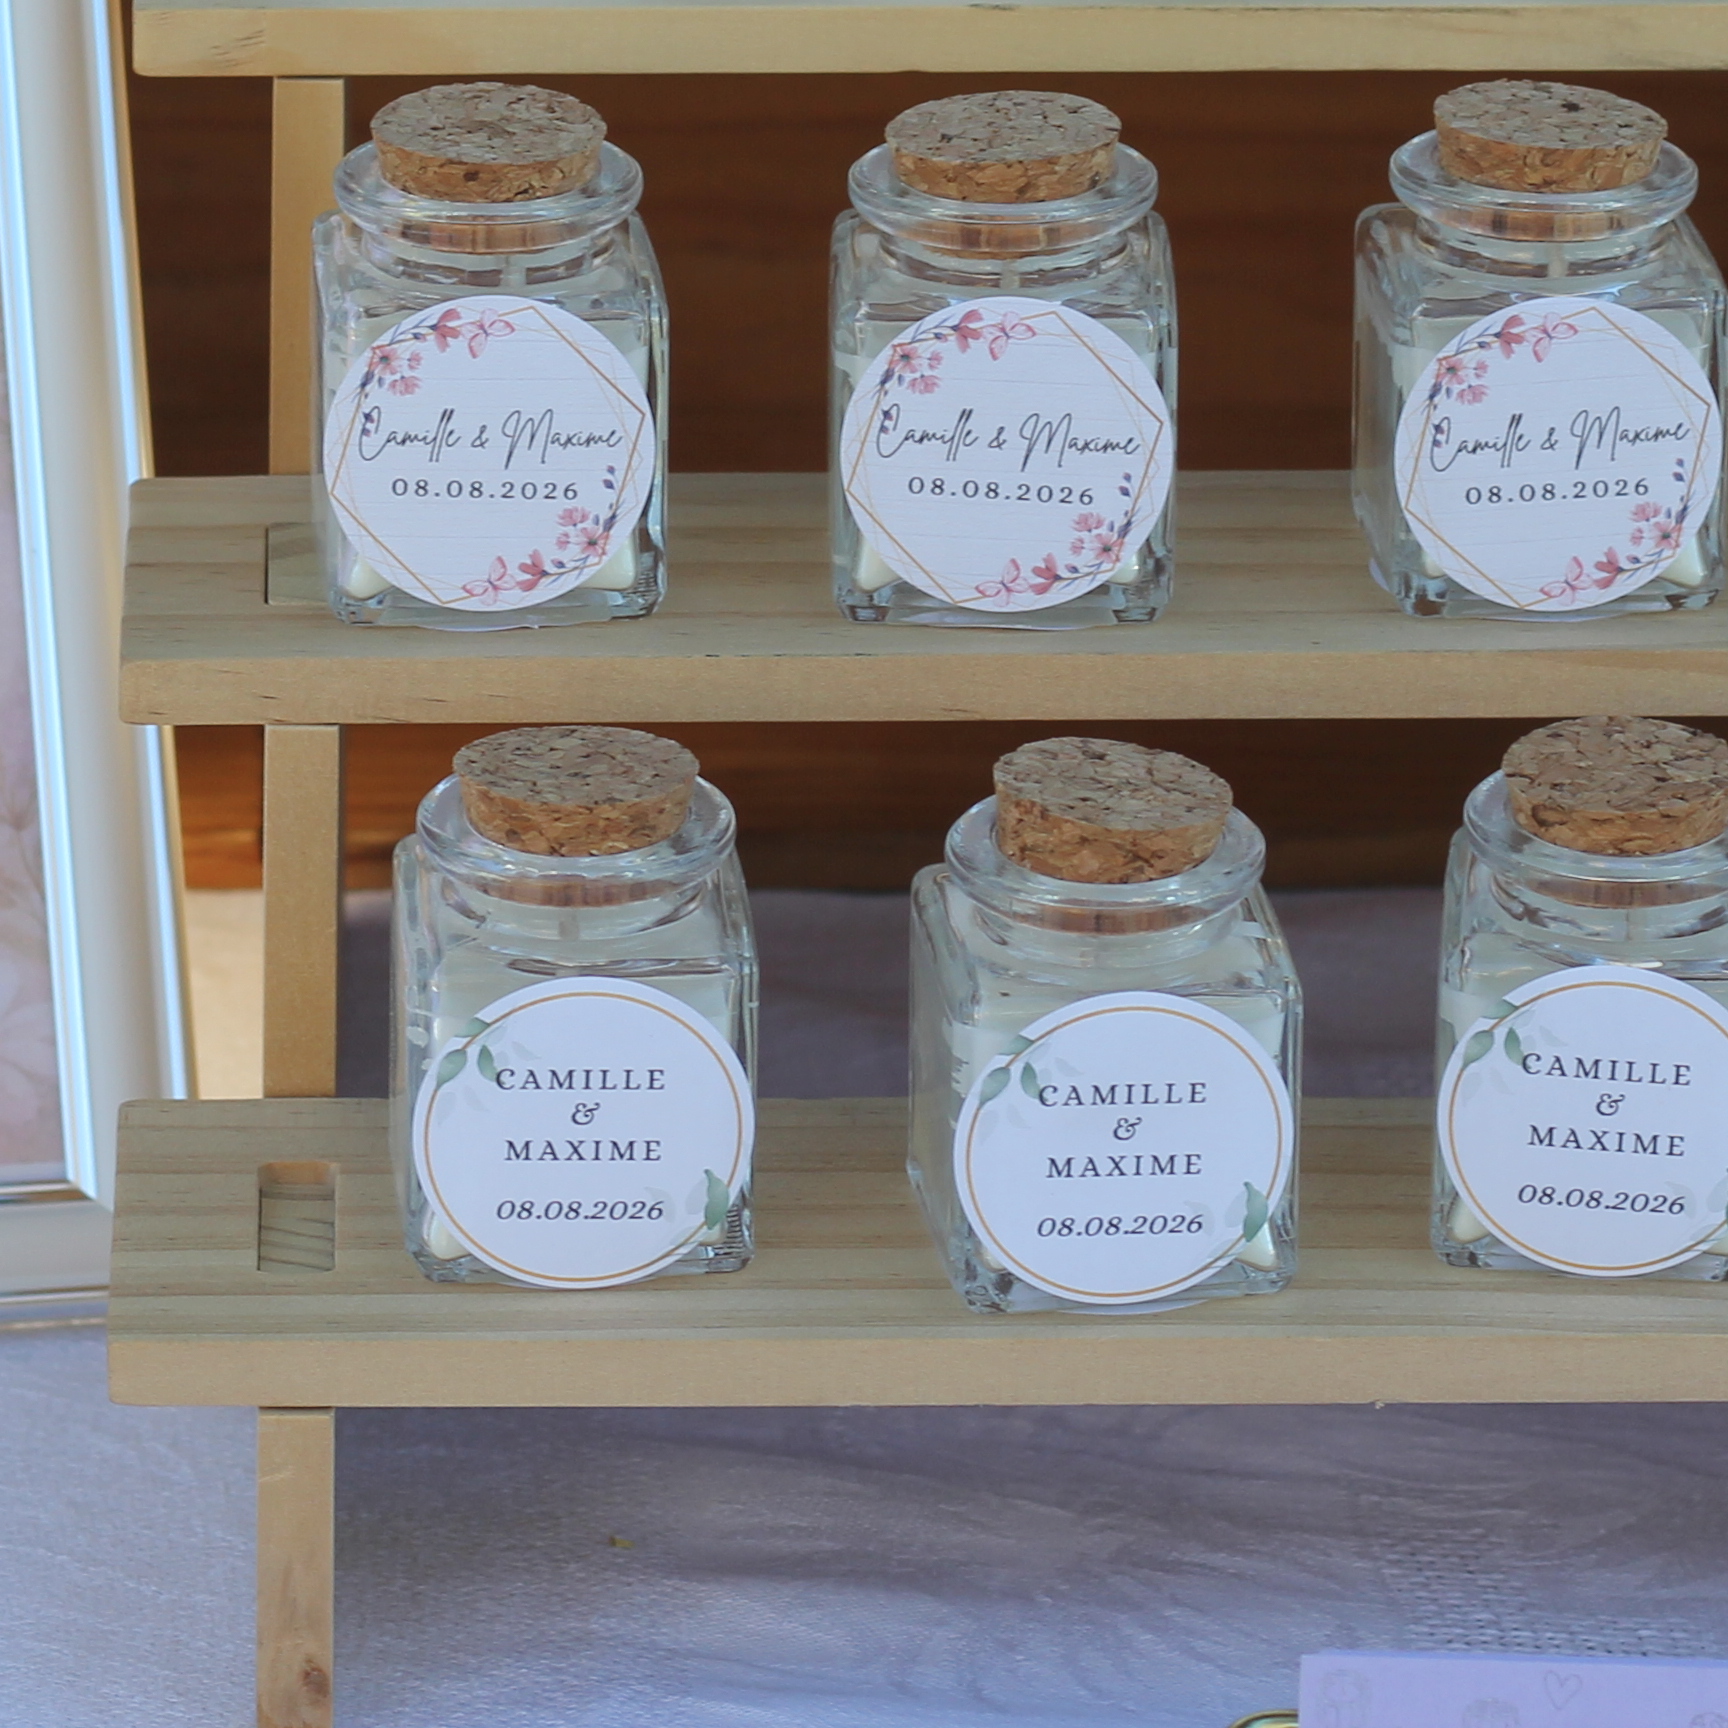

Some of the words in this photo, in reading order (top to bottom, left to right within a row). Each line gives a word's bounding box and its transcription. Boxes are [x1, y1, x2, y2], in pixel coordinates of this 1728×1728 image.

[358, 404, 464, 463] Camille
[471, 426, 490, 449] &
[502, 409, 624, 470] Maxime
[876, 403, 979, 465] Camille
[988, 426, 1007, 449] &
[1018, 411, 1143, 472] Maxime
[1430, 411, 1530, 472] Camille
[1540, 427, 1559, 450] &
[1570, 405, 1690, 469] Maxime
[391, 478, 578, 502] 08.08.2026
[907, 476, 1095, 506] 08.08.2026
[1465, 478, 1649, 505] 08.08.2026
[495, 1067, 667, 1092] CAMILLE
[1520, 1052, 1693, 1087] CAMILLE
[1038, 1082, 1208, 1108] CAMILLE
[1595, 1093, 1625, 1117] &
[571, 1101, 601, 1126] &
[1113, 1116, 1143, 1142] &
[1528, 1124, 1686, 1158] MAXIME
[504, 1139, 663, 1163] MAXIME
[1046, 1153, 1203, 1179] MAXIME
[495, 1200, 665, 1222] 08.08.2026
[1517, 1184, 1686, 1217] 08.08.2026
[1037, 1214, 1204, 1238] 08.08.2026
